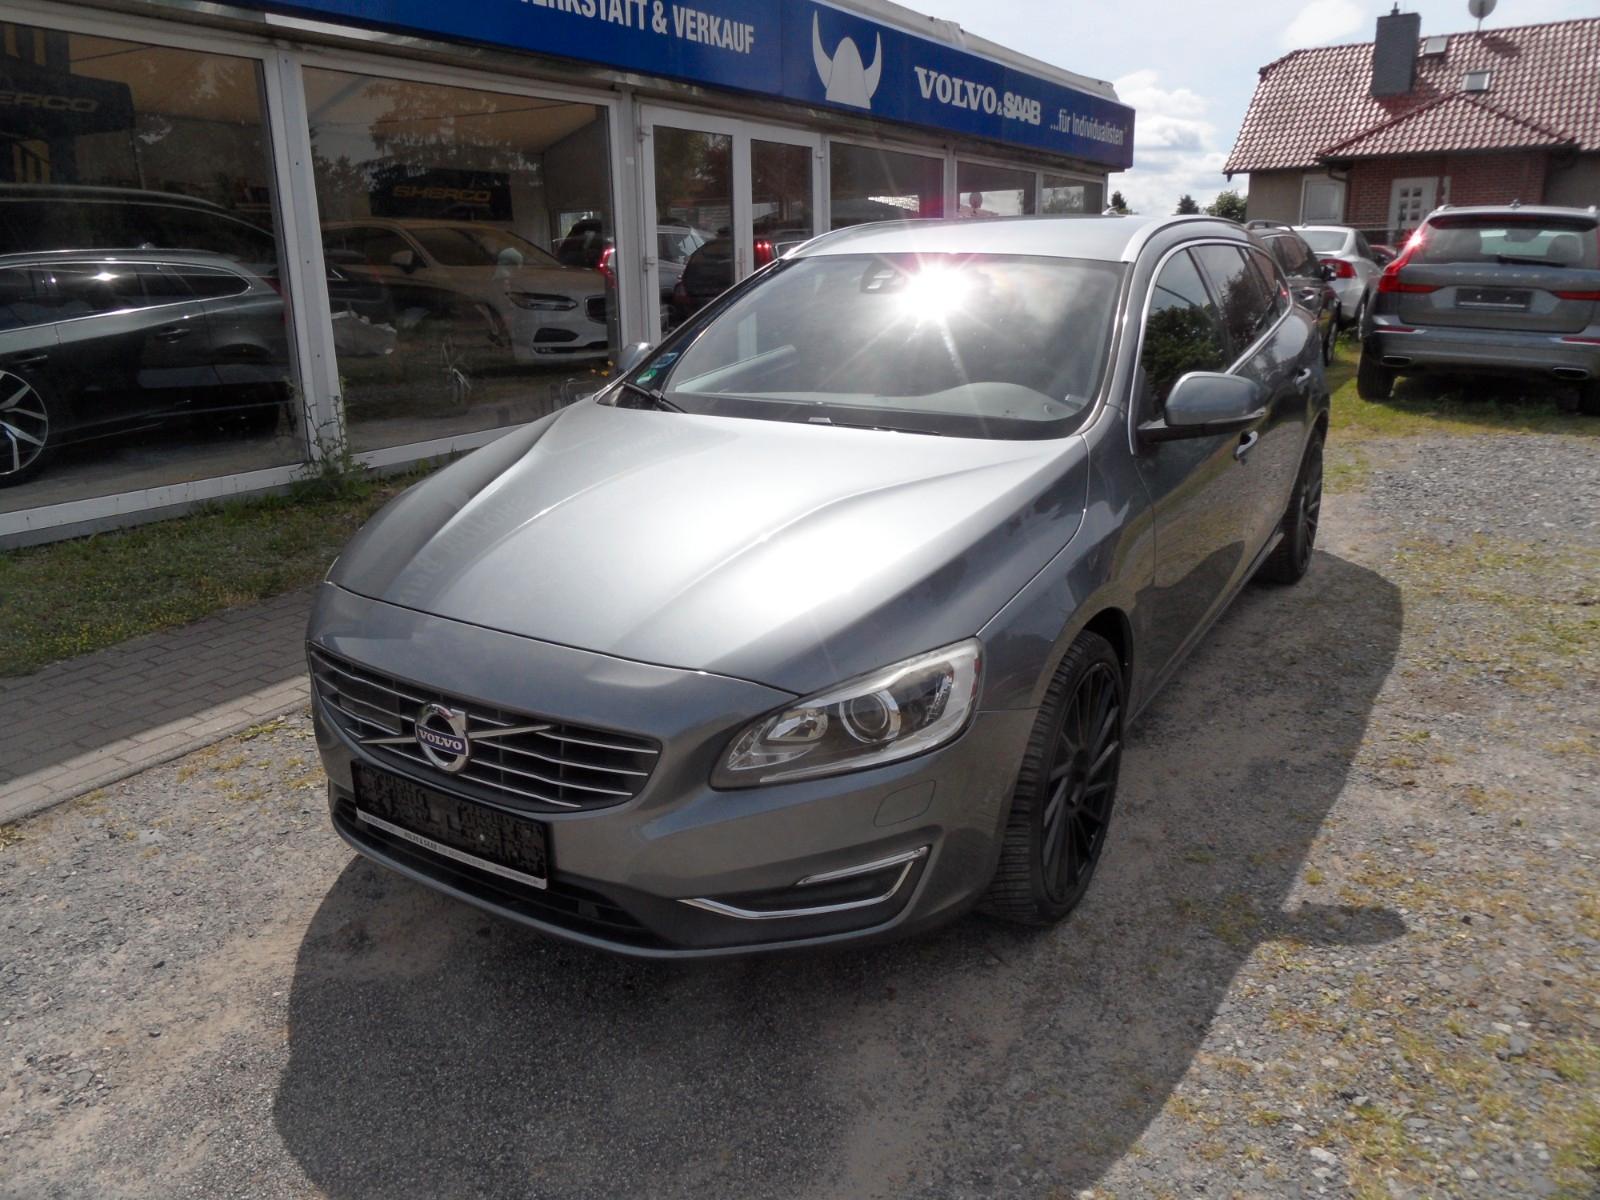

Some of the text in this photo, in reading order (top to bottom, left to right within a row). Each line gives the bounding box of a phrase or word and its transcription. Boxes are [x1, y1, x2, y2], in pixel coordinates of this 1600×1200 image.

[520, 0, 755, 54] STATT & VERKAUF
[914, 66, 997, 114] VOLVO
[1003, 91, 1041, 125] SAAB
[393, 186, 491, 201] SHERCO
[419, 730, 463, 751] VOLVO
